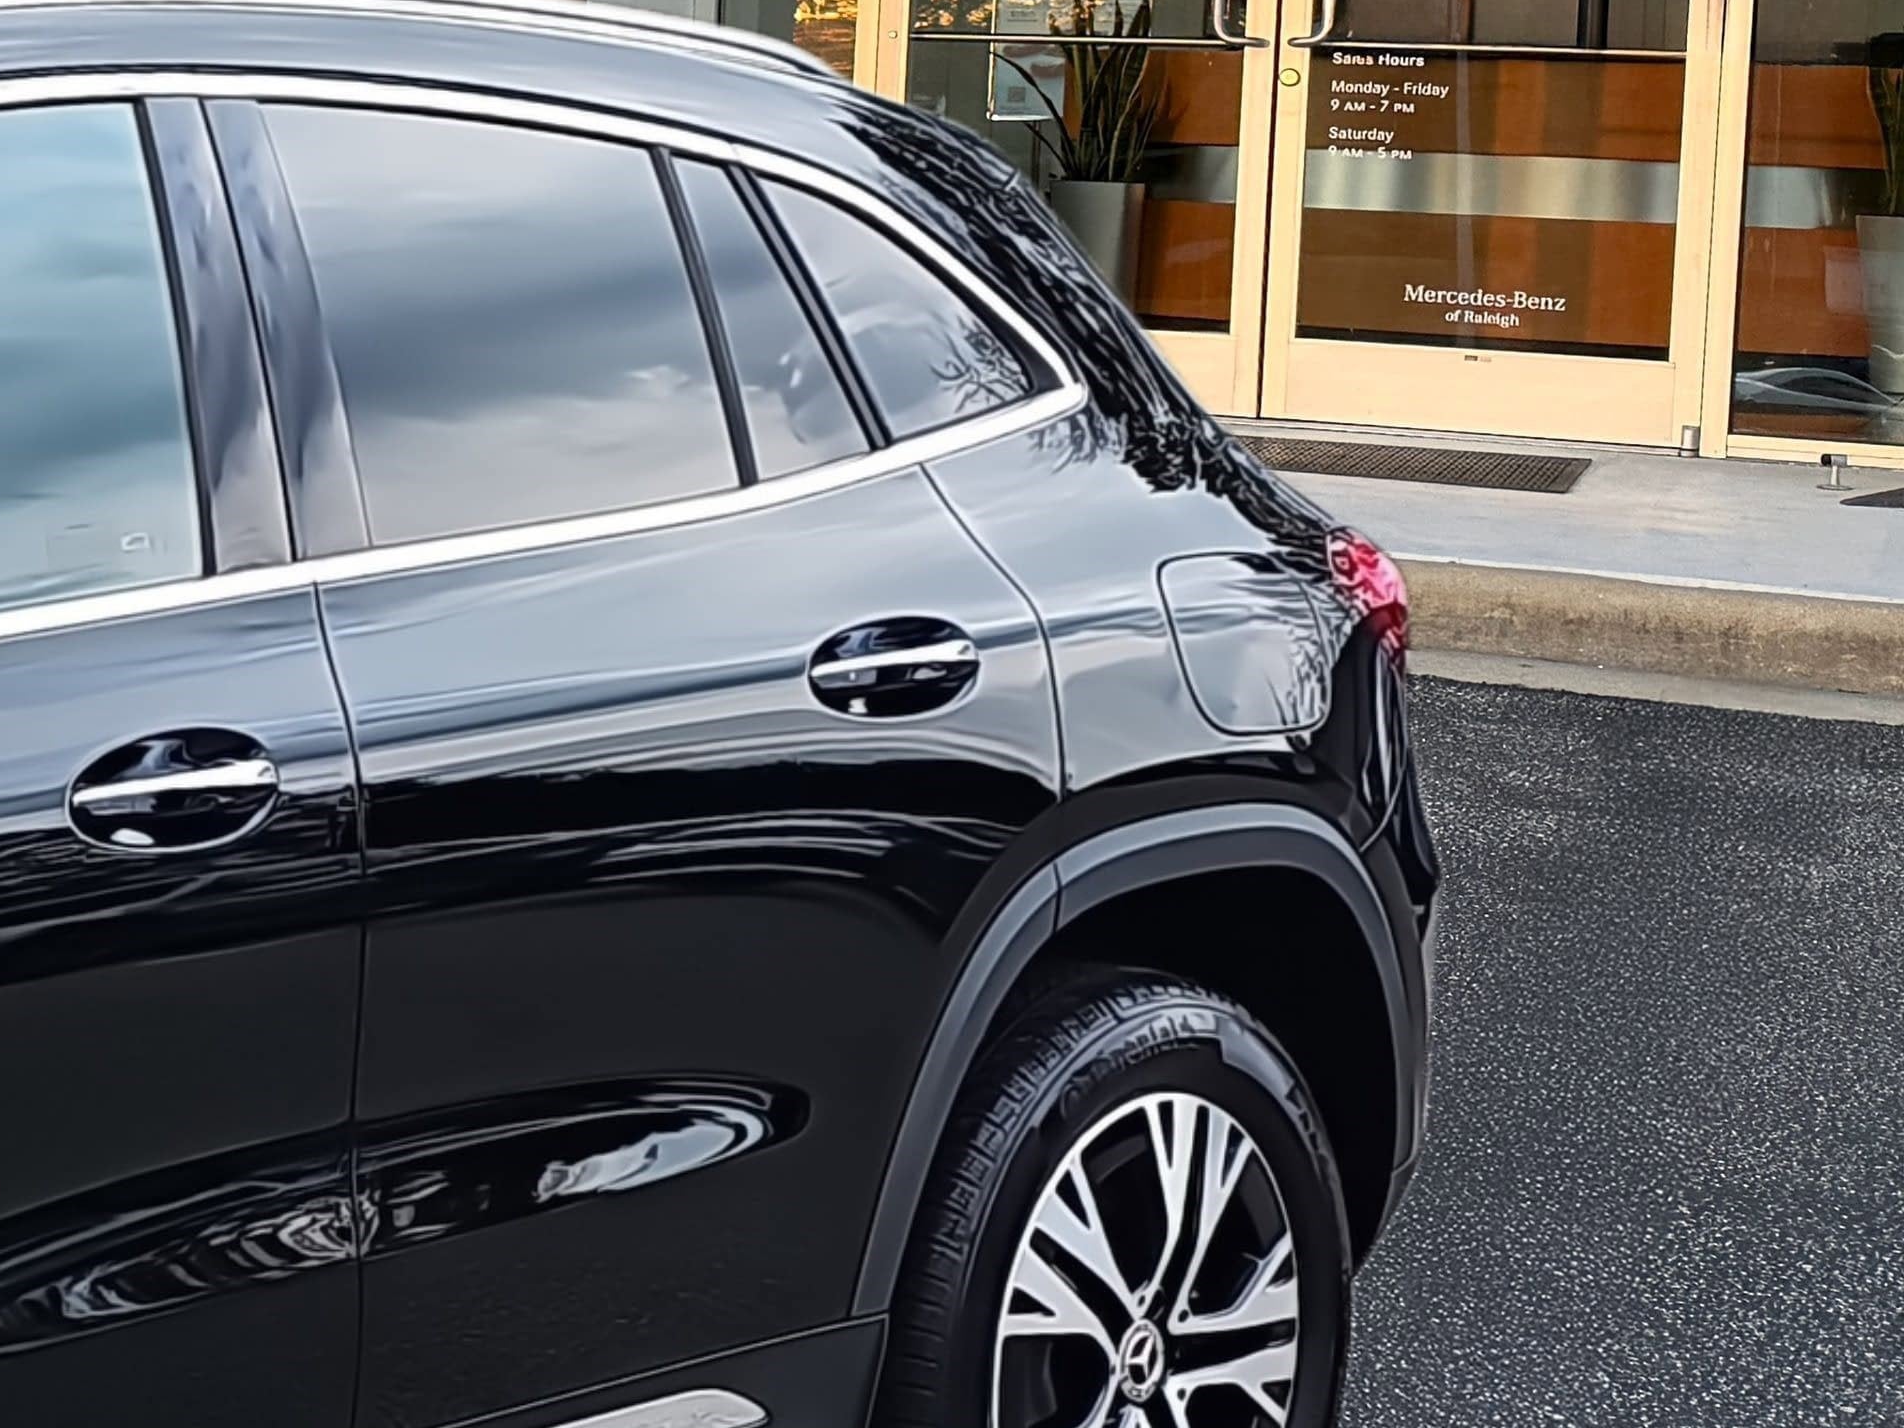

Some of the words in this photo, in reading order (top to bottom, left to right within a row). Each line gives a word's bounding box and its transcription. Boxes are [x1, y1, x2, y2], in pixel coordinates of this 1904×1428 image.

[1378, 52, 1425, 67] Hours
[1330, 79, 1390, 97] Monday
[1403, 81, 1449, 98] Friday
[1330, 98, 1341, 111] 9
[1343, 101, 1366, 112] AM
[1379, 99, 1390, 113] 7
[1393, 102, 1415, 114] PM
[1328, 126, 1395, 144] Saturday
[1377, 146, 1387, 159] 5
[1391, 149, 1413, 160] PM
[1403, 283, 1566, 312] Mercedes-Benz
[1445, 309, 1462, 323] of
[1463, 310, 1520, 328] Raleigh
